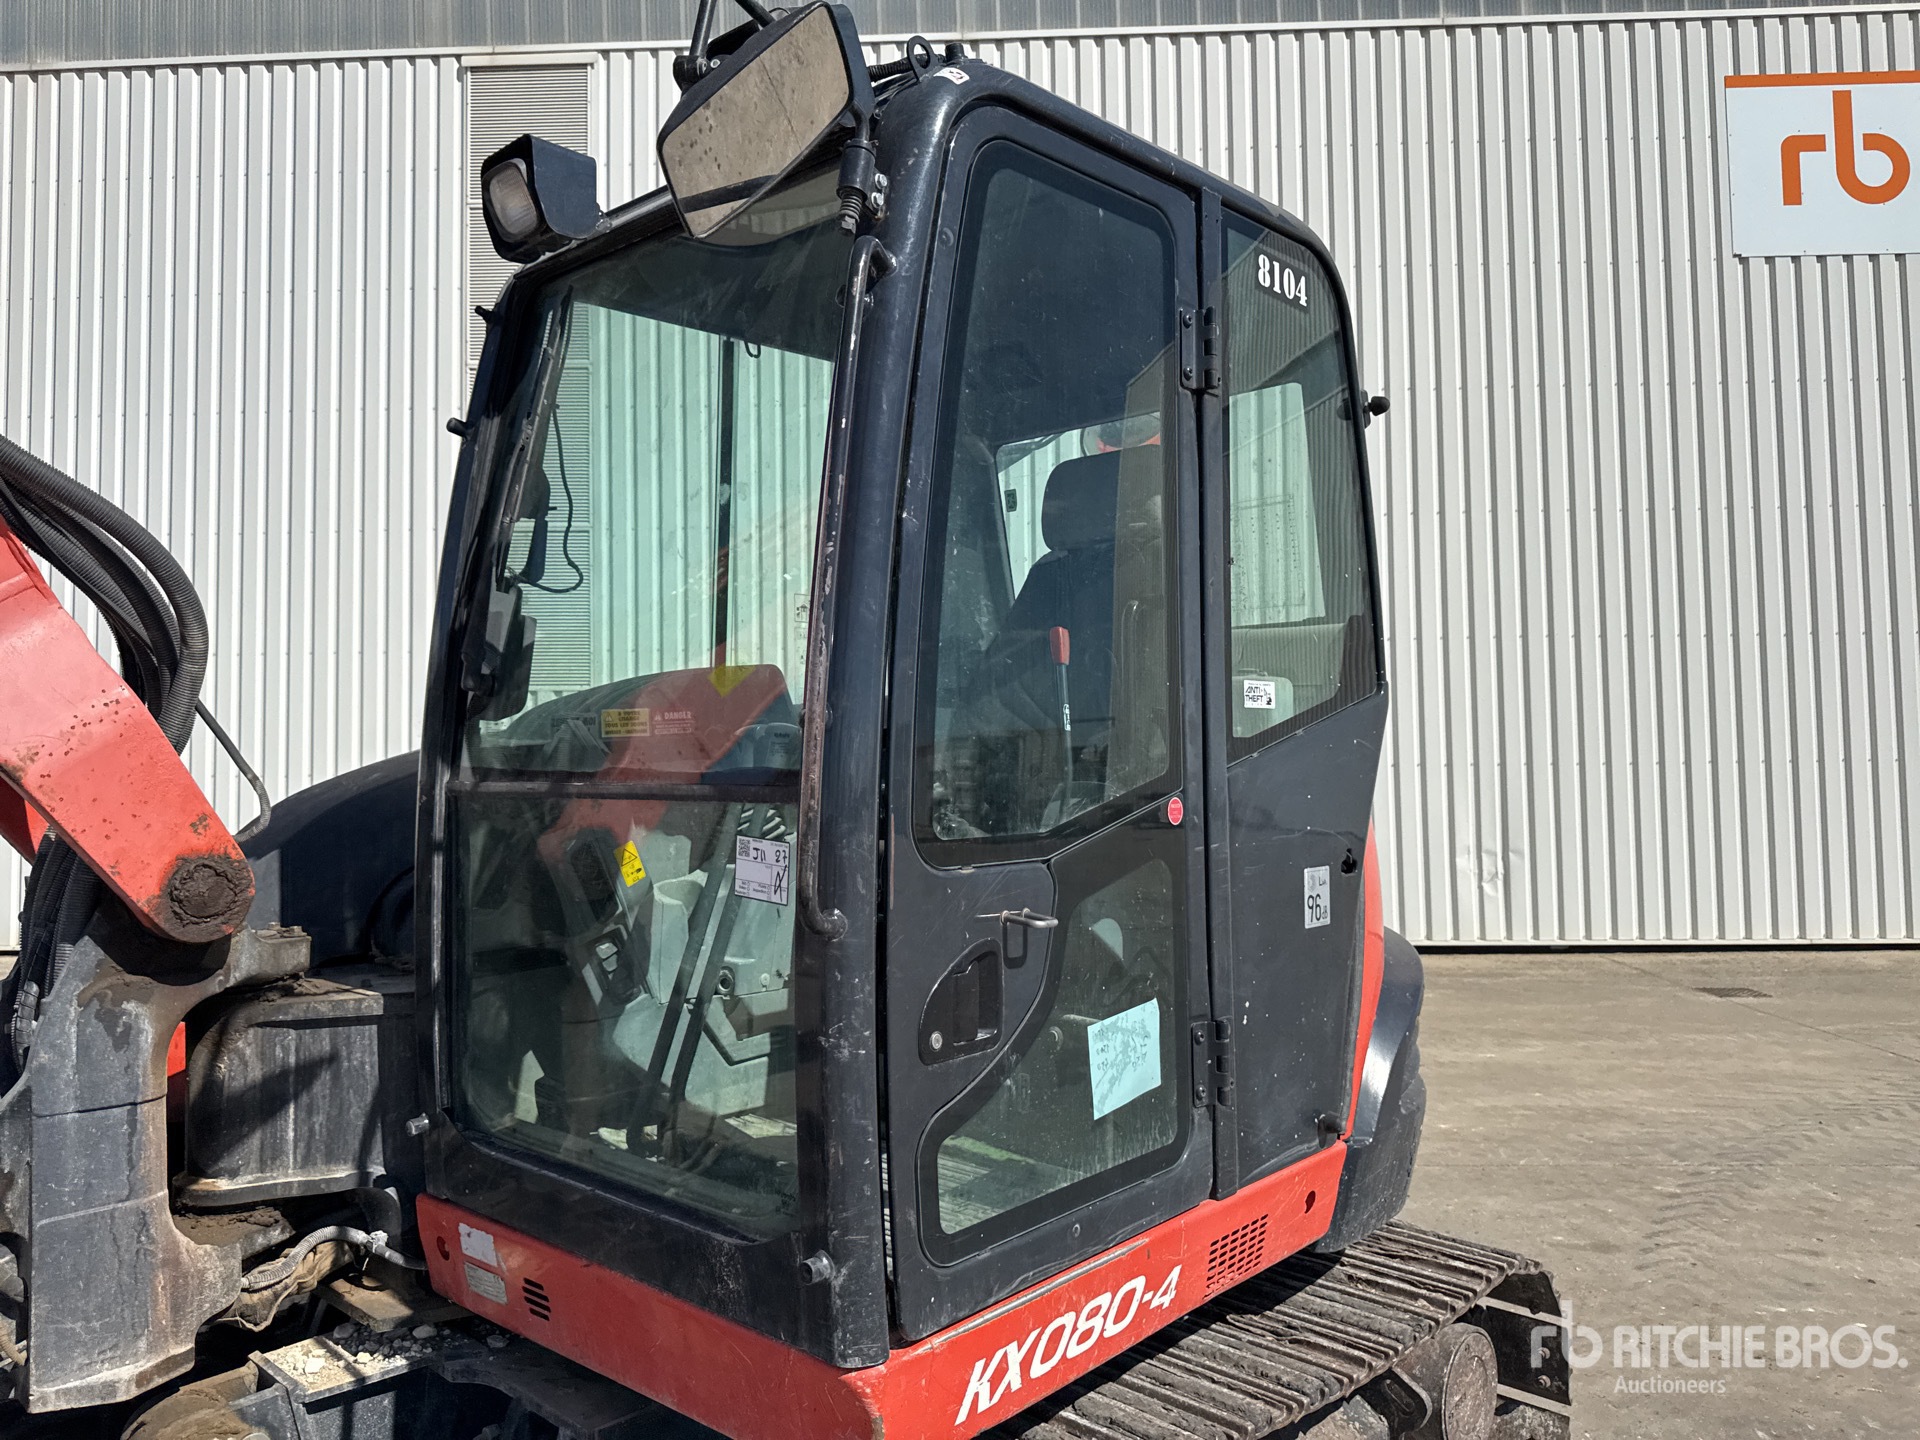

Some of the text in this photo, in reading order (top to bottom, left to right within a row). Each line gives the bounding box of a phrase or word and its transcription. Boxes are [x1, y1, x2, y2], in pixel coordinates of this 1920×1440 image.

[1780, 89, 1911, 206] rb
[1257, 253, 1308, 307] 8104
[664, 711, 692, 720] DANGER
[774, 849, 788, 864] 27
[1307, 893, 1322, 923] 96
[954, 1264, 1182, 1427] KX080-4
